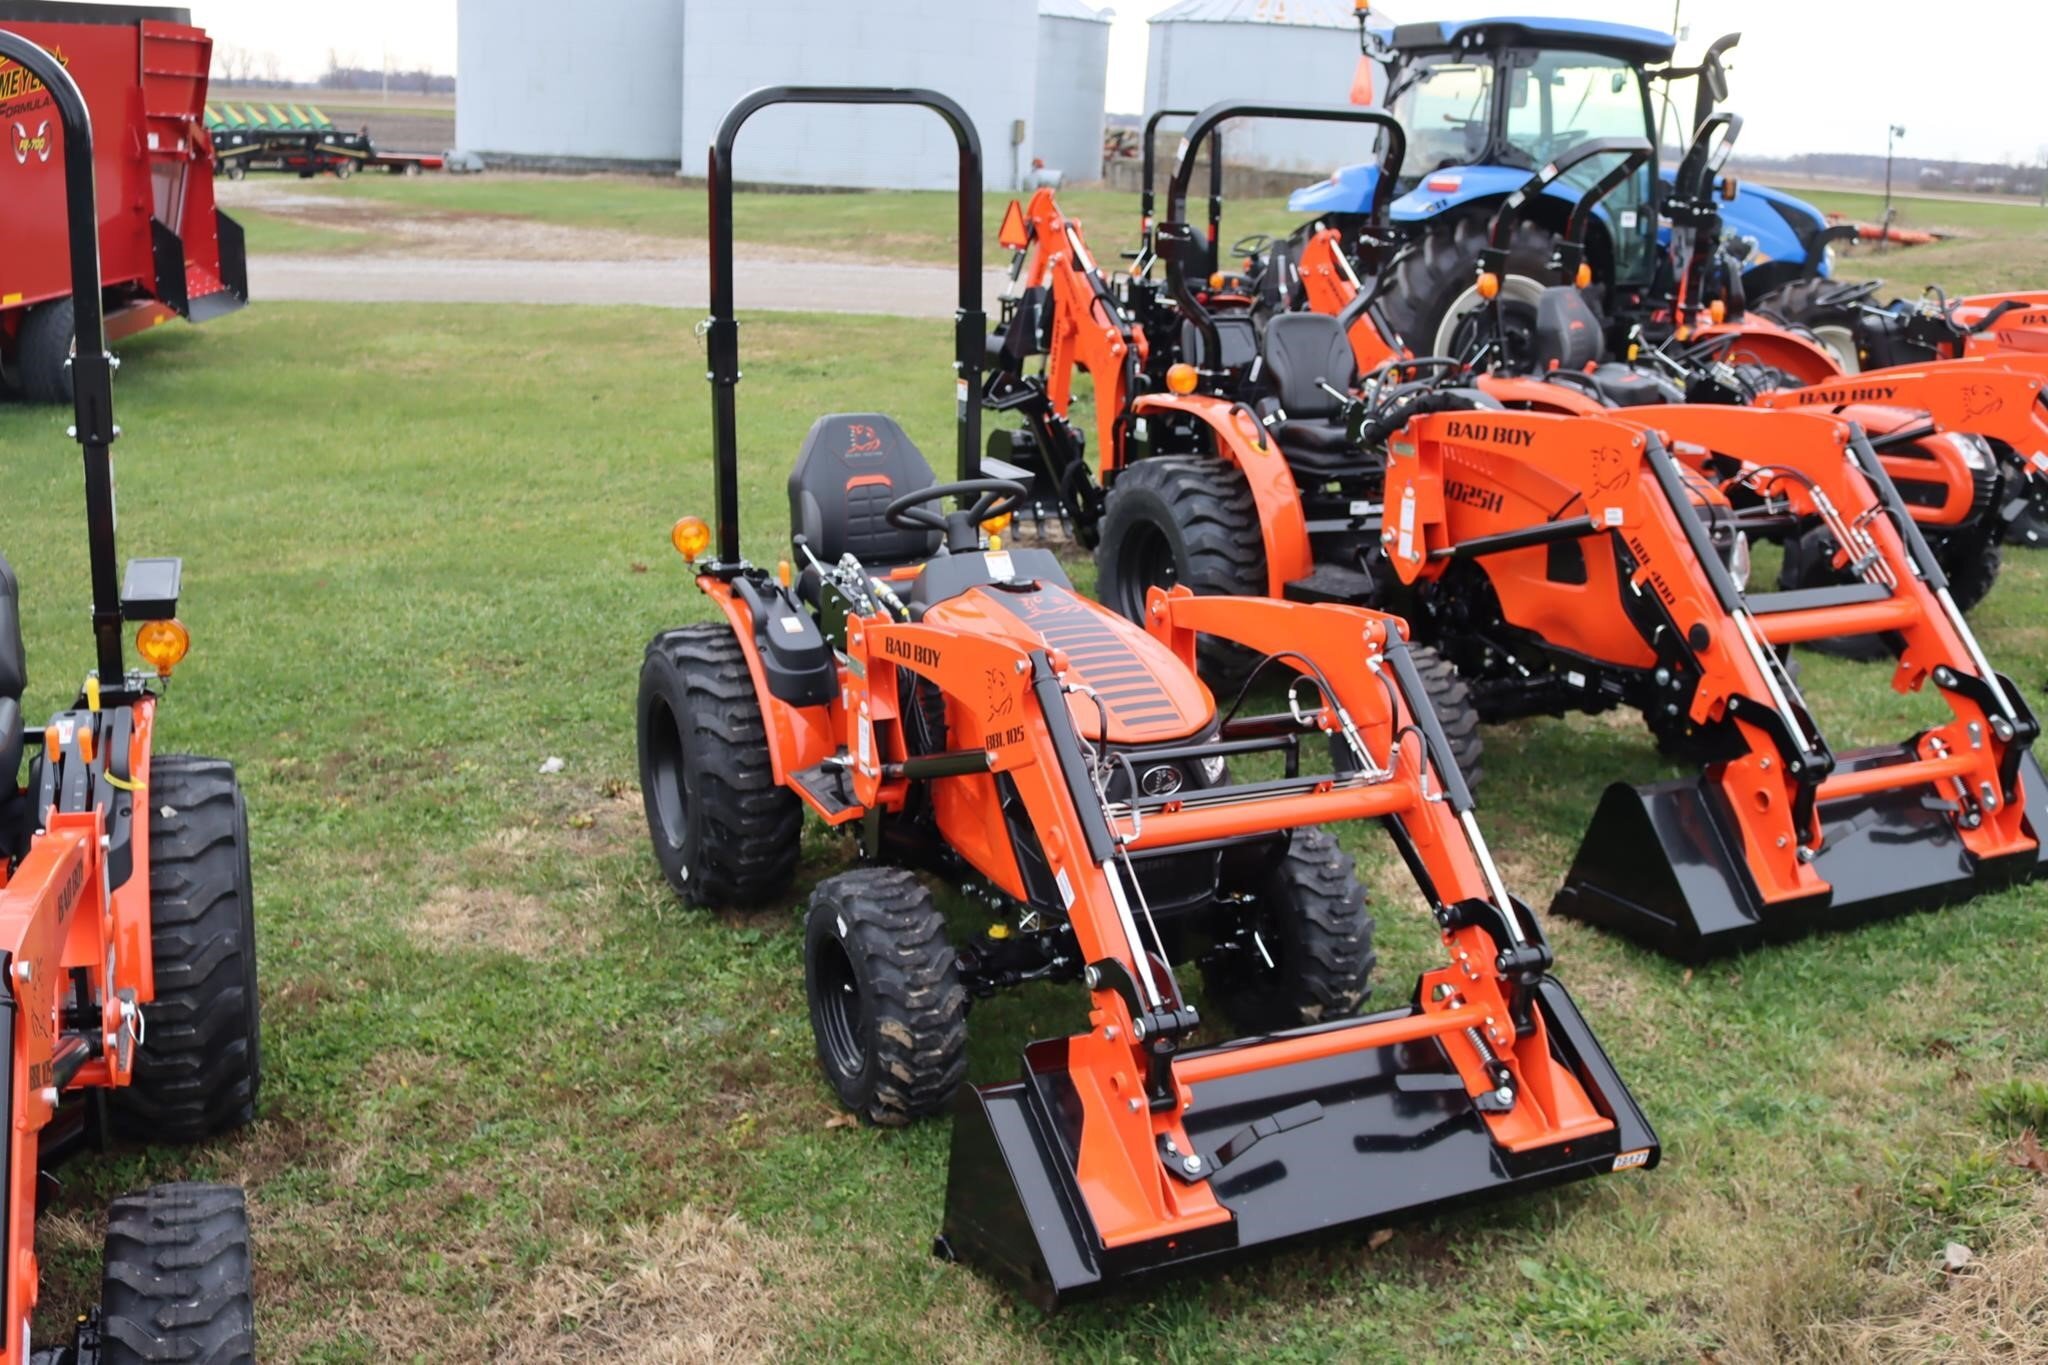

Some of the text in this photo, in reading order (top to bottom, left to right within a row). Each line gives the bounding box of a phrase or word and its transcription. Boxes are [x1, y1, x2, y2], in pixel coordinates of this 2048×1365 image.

[0, 68, 45, 100] MEYE
[1799, 387, 1897, 404] BAD BOY
[1447, 421, 1536, 447] BAD BOY
[885, 636, 941, 669] BAD BOY
[1006, 724, 1025, 745] 105
